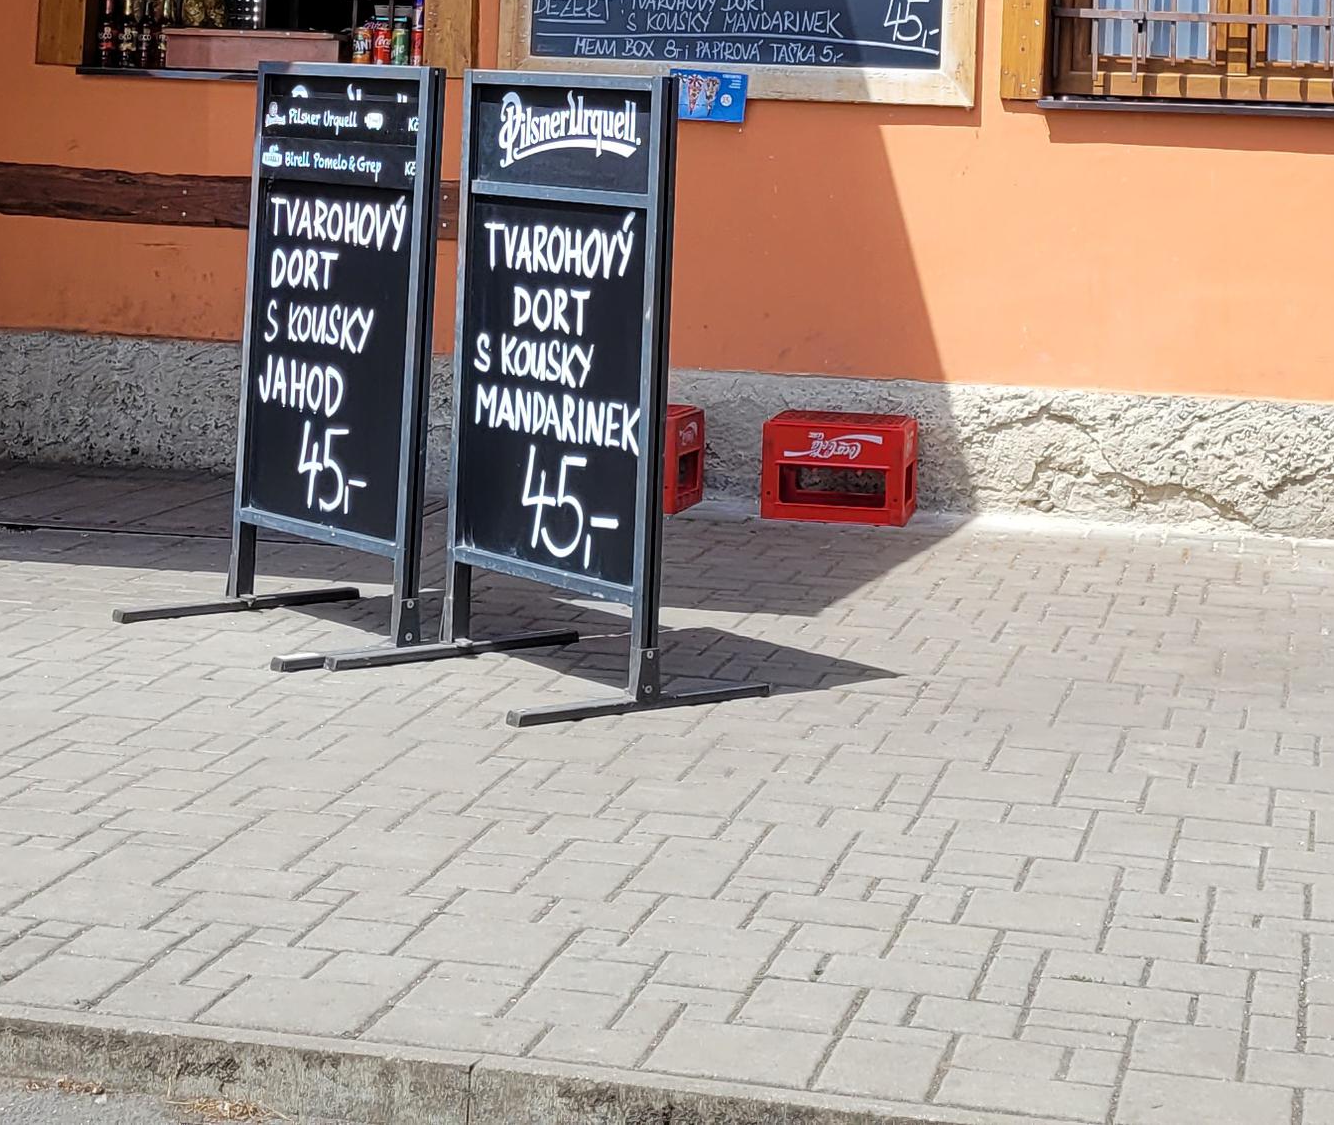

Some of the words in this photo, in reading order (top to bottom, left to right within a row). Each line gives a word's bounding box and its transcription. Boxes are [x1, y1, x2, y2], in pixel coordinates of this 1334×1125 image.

[573, 37, 617, 56] MENU
[622, 38, 655, 57] BOX
[695, 39, 764, 61] PAPÍROVÁ
[769, 41, 815, 63] TAŠKA
[627, 12, 637, 32] S
[646, 11, 712, 33] KOUSKY
[723, 9, 844, 39] MANDARINEK
[288, 107, 321, 125] Pilsner
[323, 109, 358, 136] Urquell
[408, 116, 419, 131] Kč
[499, 91, 569, 168] Pilsner
[567, 90, 637, 158] Urquell
[284, 150, 311, 168] Birell
[313, 152, 348, 171] Pomelo
[348, 155, 356, 173] &
[357, 155, 382, 183] Grep
[404, 160, 417, 176] Kč
[270, 195, 407, 252] TVAROHOVÝ
[483, 211, 636, 280] TVAROHOVÝ
[270, 248, 339, 291] DORT
[264, 299, 278, 343] S
[287, 301, 375, 354] KOUSKY
[513, 286, 591, 337] DORT
[258, 354, 344, 418] JAHOD
[473, 332, 492, 374] S
[501, 334, 595, 389] KOUSKY
[474, 382, 641, 457] MANDARINEK
